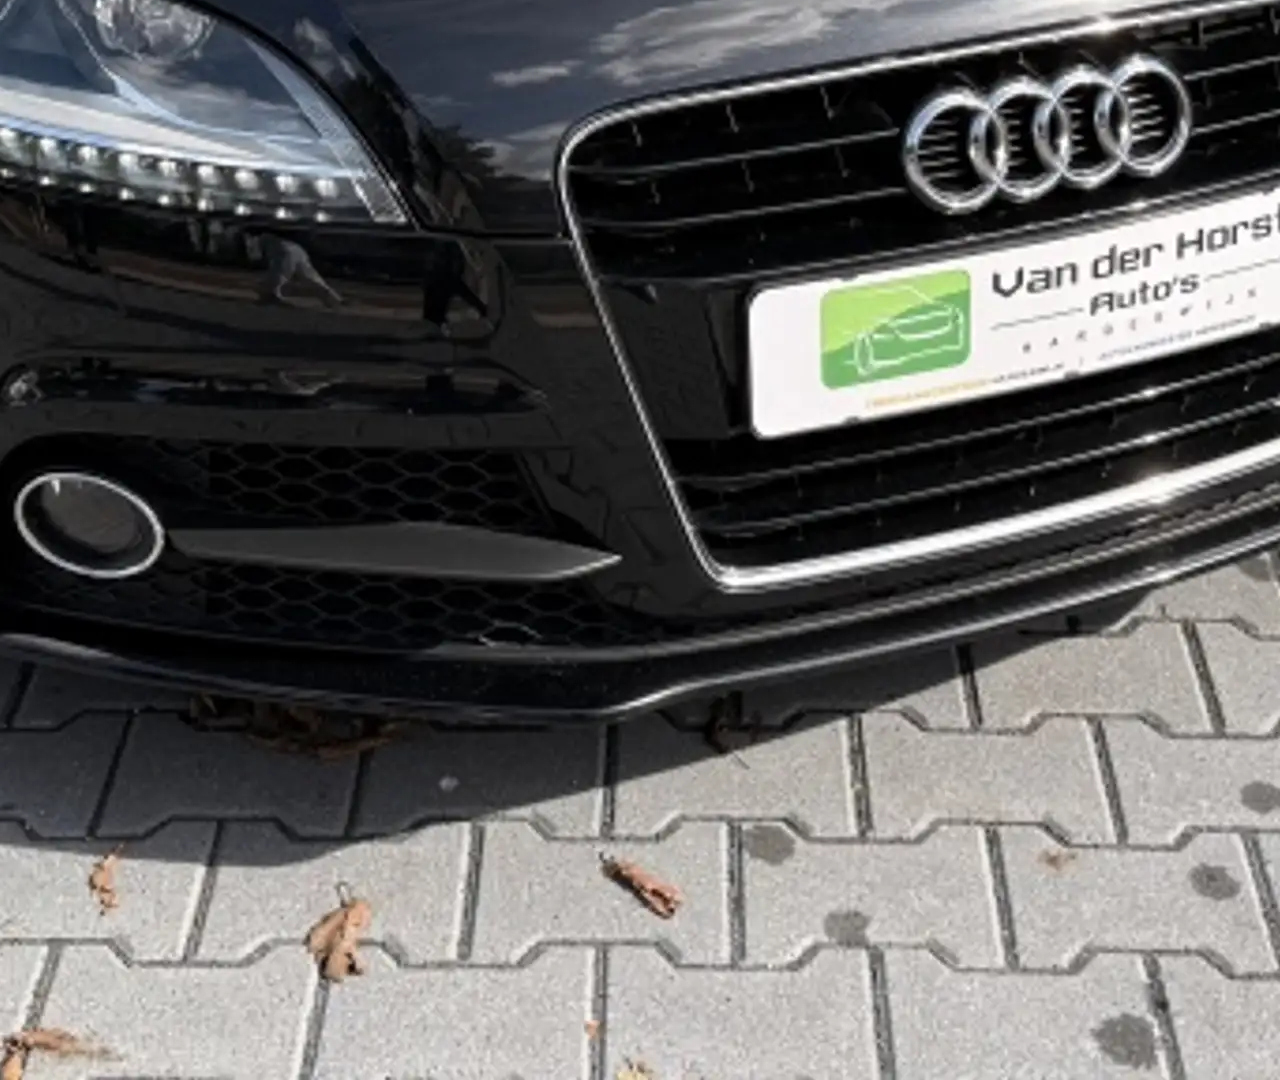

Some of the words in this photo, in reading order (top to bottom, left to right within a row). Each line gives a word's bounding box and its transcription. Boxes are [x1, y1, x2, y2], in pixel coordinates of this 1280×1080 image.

[991, 262, 1079, 299] Van
[1091, 243, 1165, 280] der
[1089, 274, 1200, 317] Auto's
